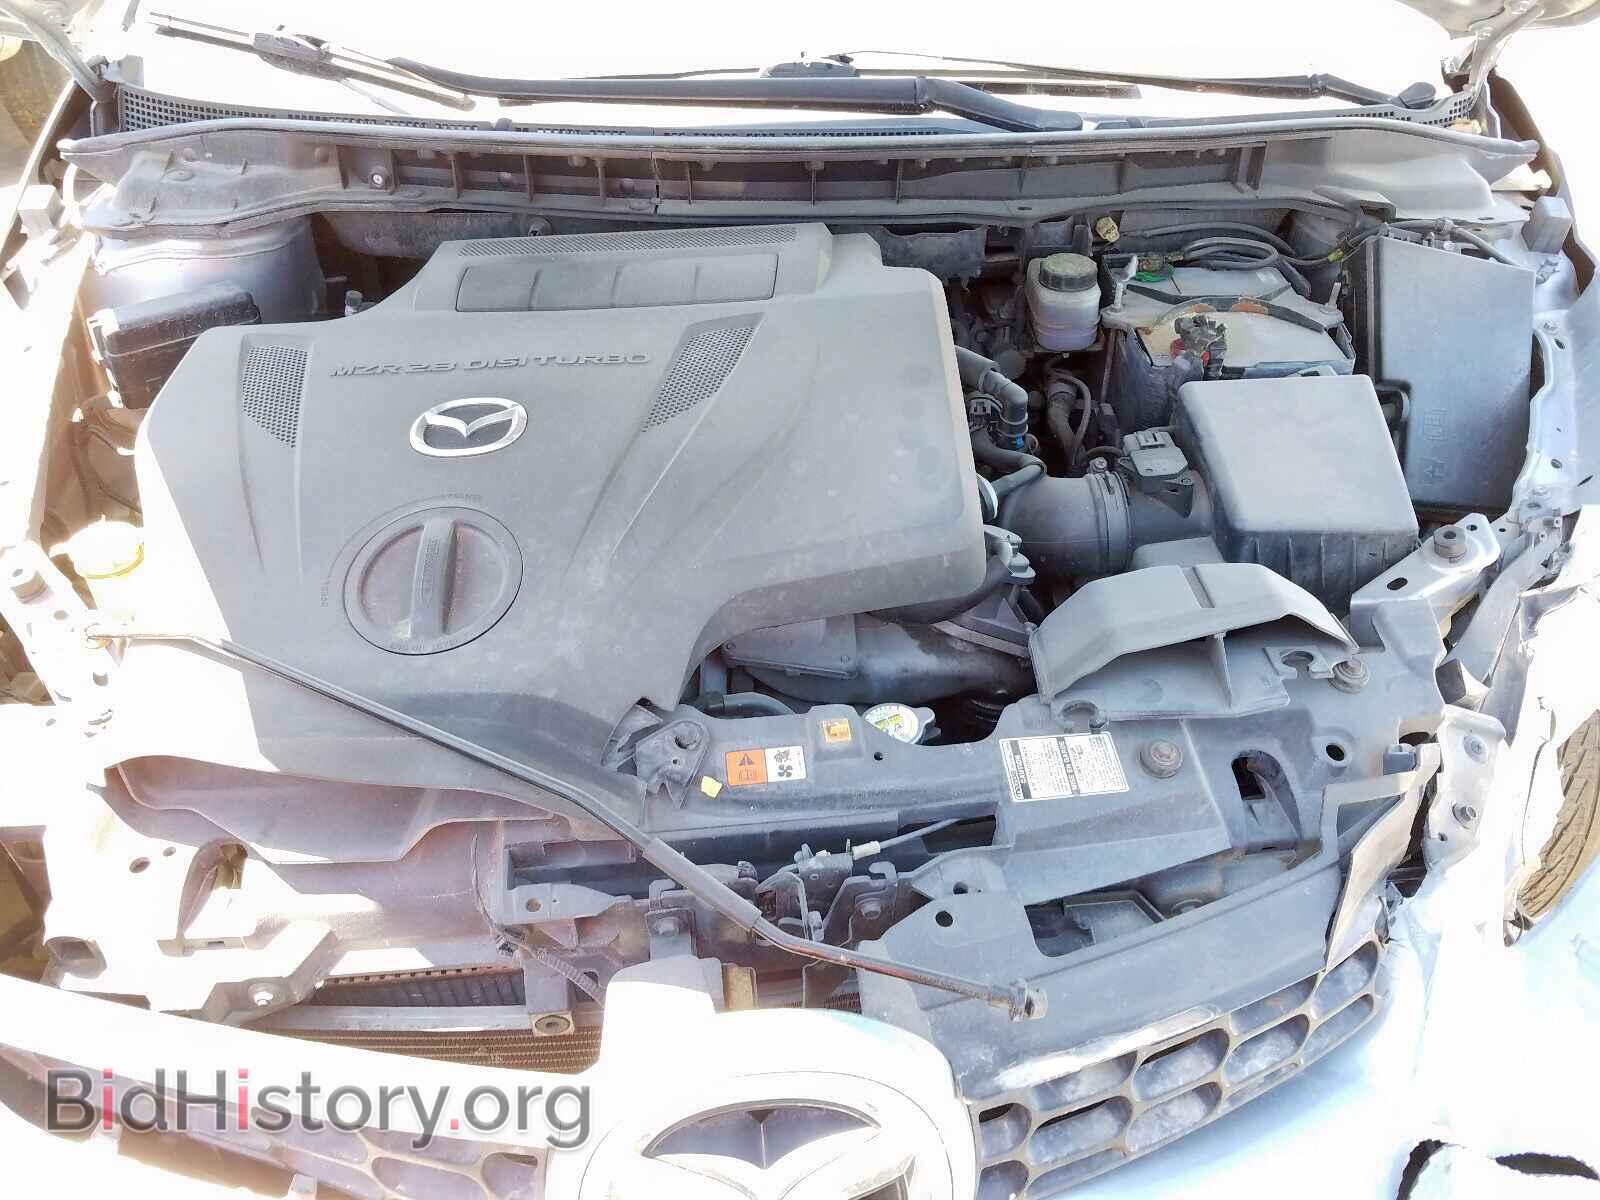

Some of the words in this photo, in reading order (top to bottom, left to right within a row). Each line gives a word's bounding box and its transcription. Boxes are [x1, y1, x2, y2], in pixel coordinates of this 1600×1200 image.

[329, 361, 401, 377] MZR
[463, 353, 529, 371] DISI
[533, 351, 652, 367] TURBO
[1014, 754, 1028, 785] CAUTION
